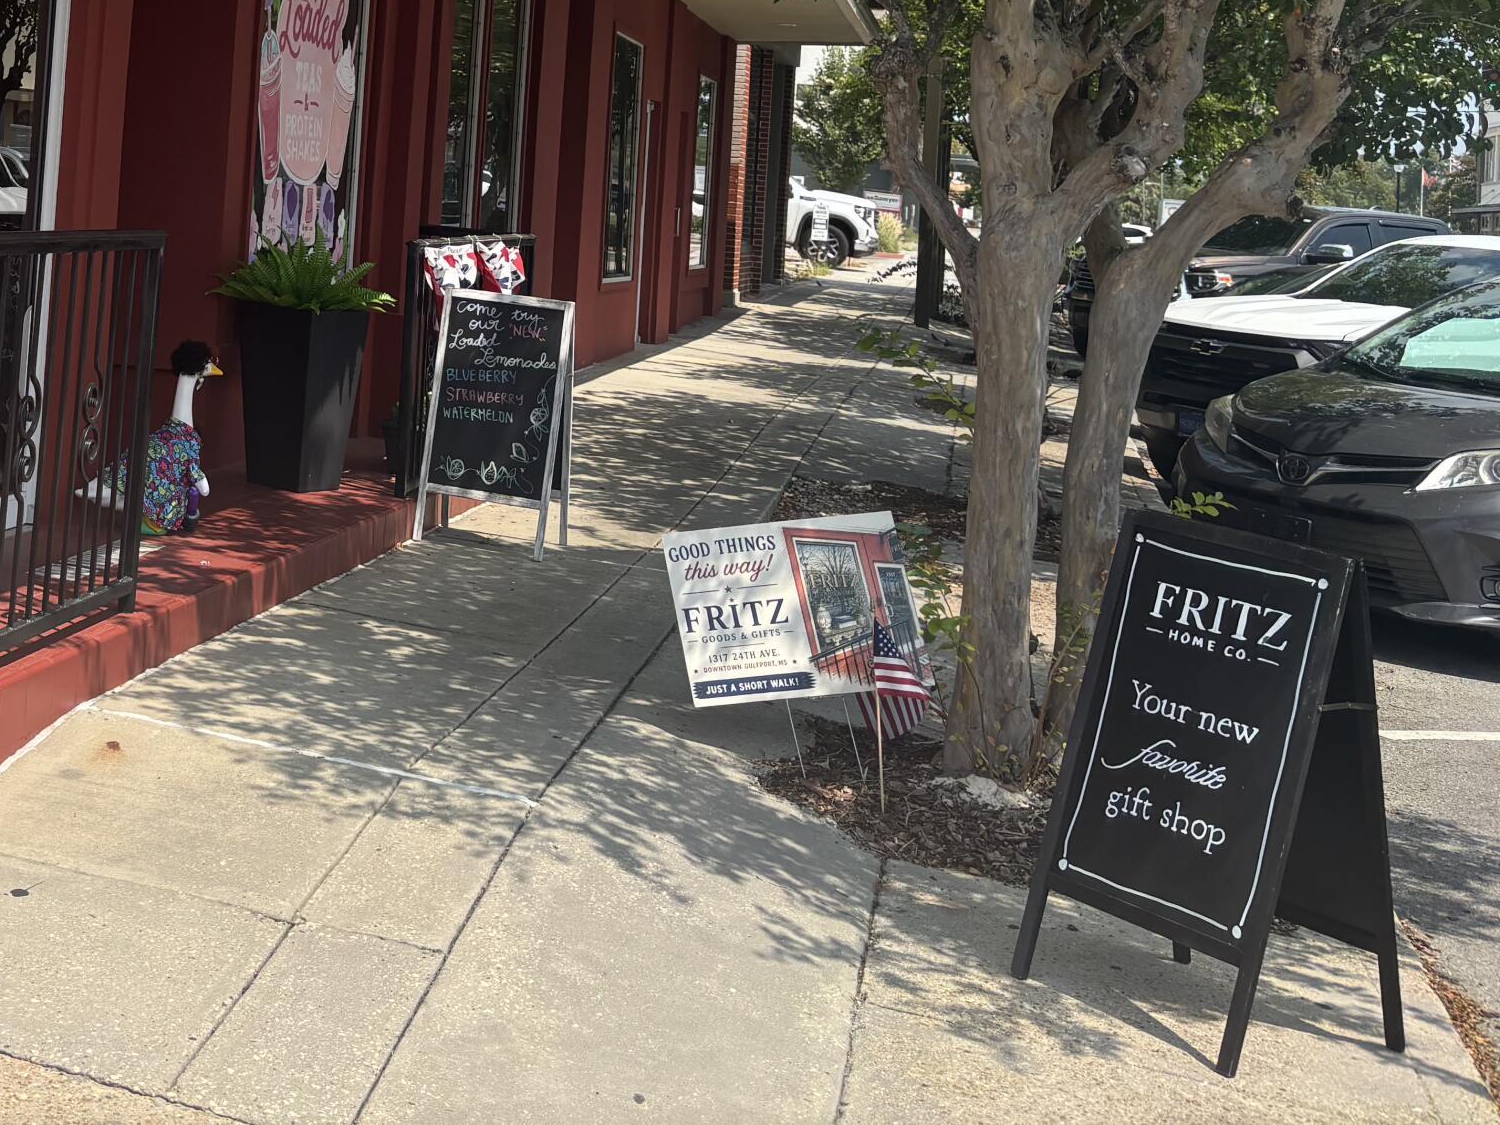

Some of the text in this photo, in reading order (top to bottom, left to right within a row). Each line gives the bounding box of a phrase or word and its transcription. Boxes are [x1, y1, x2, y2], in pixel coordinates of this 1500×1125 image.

[295, 61, 323, 93] TEAS
[285, 113, 323, 140] PROTEIN
[285, 138, 321, 163] SHAKES
[468, 318, 505, 332] our
[511, 309, 545, 331] try
[449, 329, 500, 350] Loaded
[474, 348, 557, 370] Lemonades
[446, 387, 525, 406] STRAWBERRY
[443, 406, 514, 424] WATERMELON
[668, 535, 776, 562] GOOD THINGS
[684, 553, 773, 581] this way!
[682, 598, 789, 633] FRITZ
[1148, 580, 1293, 652] FRITZ
[701, 628, 781, 644] GOODS & GIFTS
[1167, 628, 1252, 662] HOME CO.
[708, 648, 780, 663] 1317 24TH AVE.
[703, 664, 743, 673] DOWNTOWN
[705, 677, 799, 695] JUST A SHORT WALK!
[1131, 679, 1260, 745] Your new
[1101, 739, 1228, 790] favorite
[1105, 787, 1227, 855] gift shop
